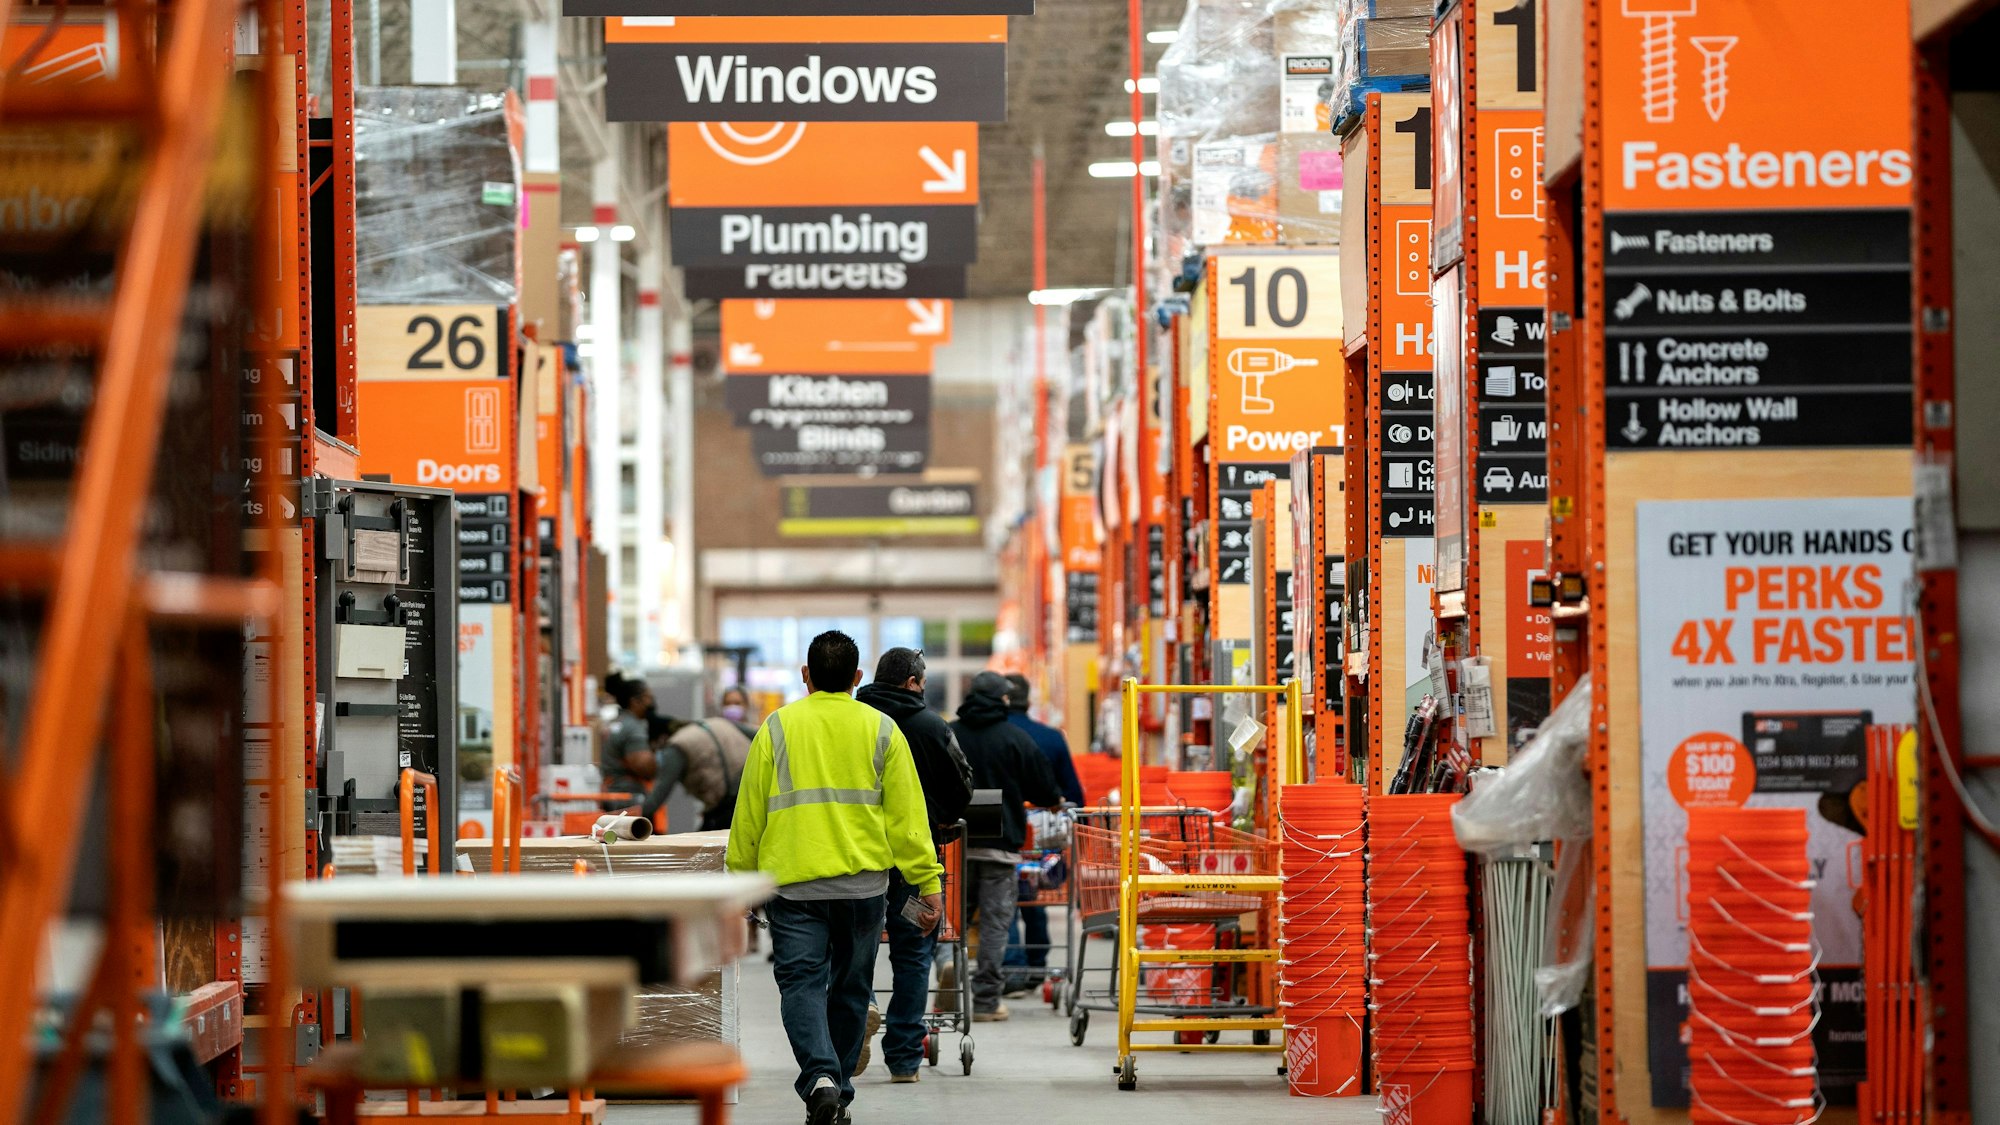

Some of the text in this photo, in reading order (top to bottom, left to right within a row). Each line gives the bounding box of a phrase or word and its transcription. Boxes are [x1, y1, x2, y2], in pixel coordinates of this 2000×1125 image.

[675, 55, 938, 104] Windows
[1622, 141, 1913, 190] Fasteners
[720, 214, 928, 263] Plumbing
[1655, 230, 1774, 254] Fasteners
[1229, 267, 1309, 328] 10
[1657, 289, 1807, 313] Nuts & Bolts
[406, 315, 485, 371] 26
[1658, 338, 1769, 361] Concrete
[1657, 363, 1760, 386] Anchors
[768, 374, 889, 408] Kitchen
[1659, 397, 1798, 421] Hollow Wall
[1226, 425, 1323, 451] Power
[1658, 424, 1761, 446] Anchors
[19, 440, 83, 463] Sidin
[417, 459, 501, 483] Doors
[1244, 470, 1277, 484] Drills
[1669, 533, 1717, 557] GET
[1725, 531, 1793, 556] YOUR
[1803, 529, 1893, 555] HANDS
[1725, 564, 1884, 611] PERKS
[1670, 618, 1737, 665] 4X
[1672, 677, 1701, 688] when
[1705, 678, 1724, 690] you
[1728, 676, 1749, 687] Join
[1752, 675, 1772, 687] Pro
[1886, 674, 1908, 688] your
[1685, 753, 1736, 776] $100
[1687, 776, 1733, 791] TODAY
